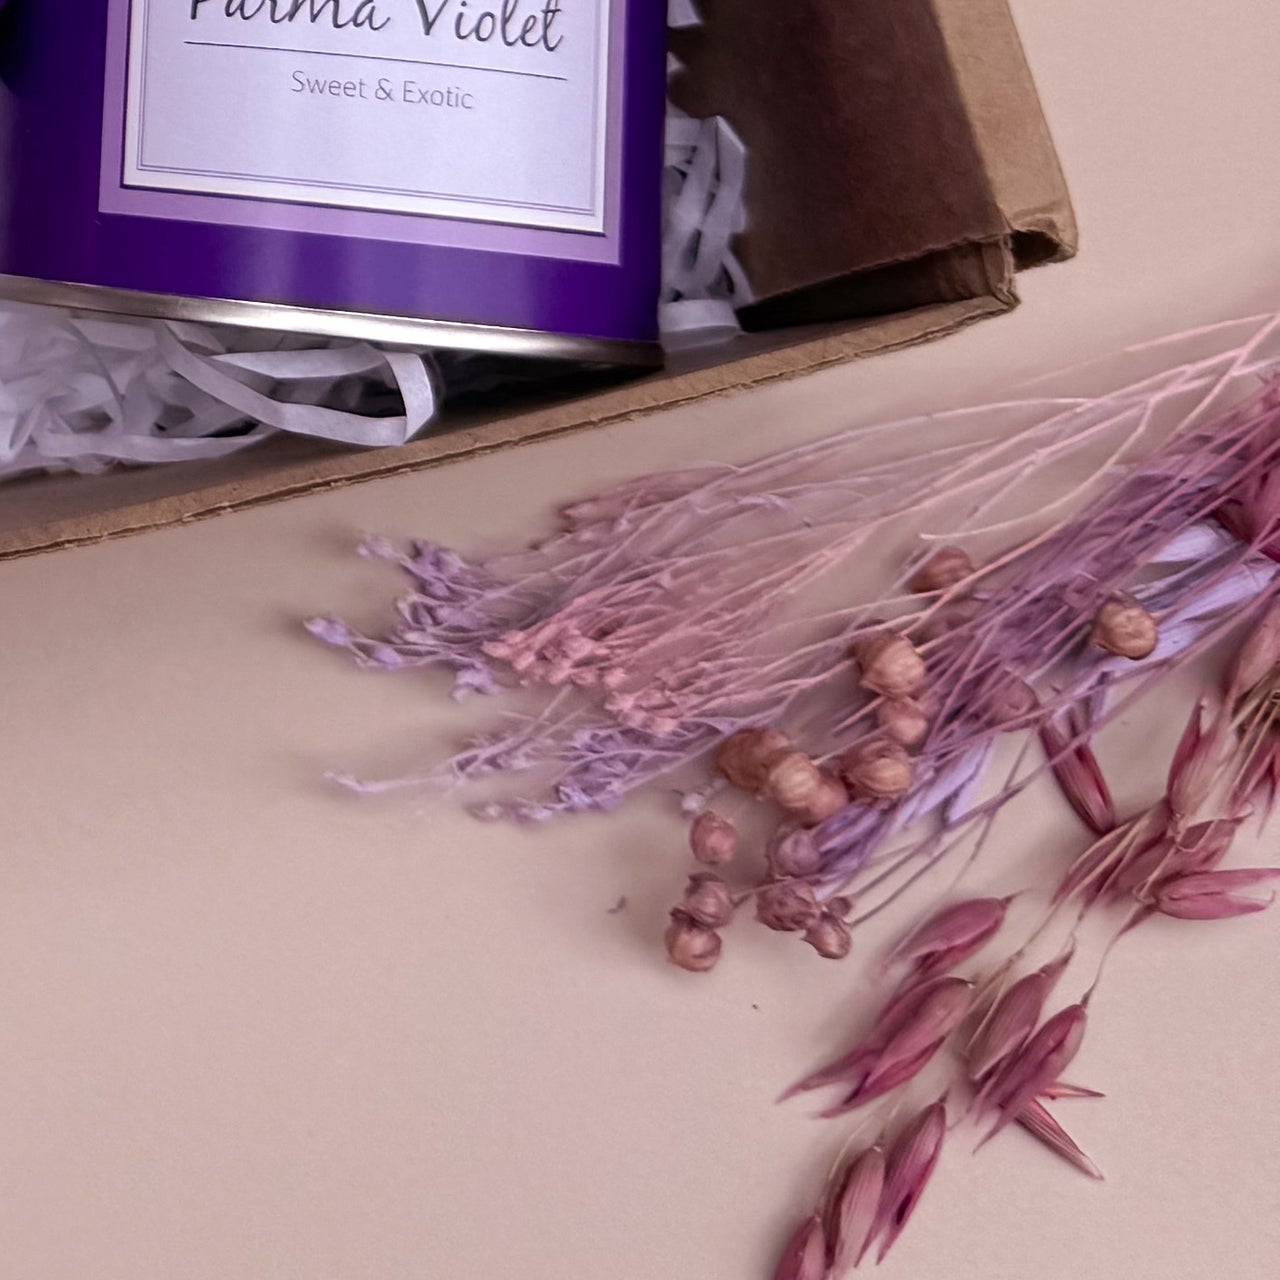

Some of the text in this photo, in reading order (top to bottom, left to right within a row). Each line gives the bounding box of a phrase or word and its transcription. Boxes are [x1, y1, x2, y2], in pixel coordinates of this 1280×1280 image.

[291, 70, 474, 110] Sweet & Exotic
